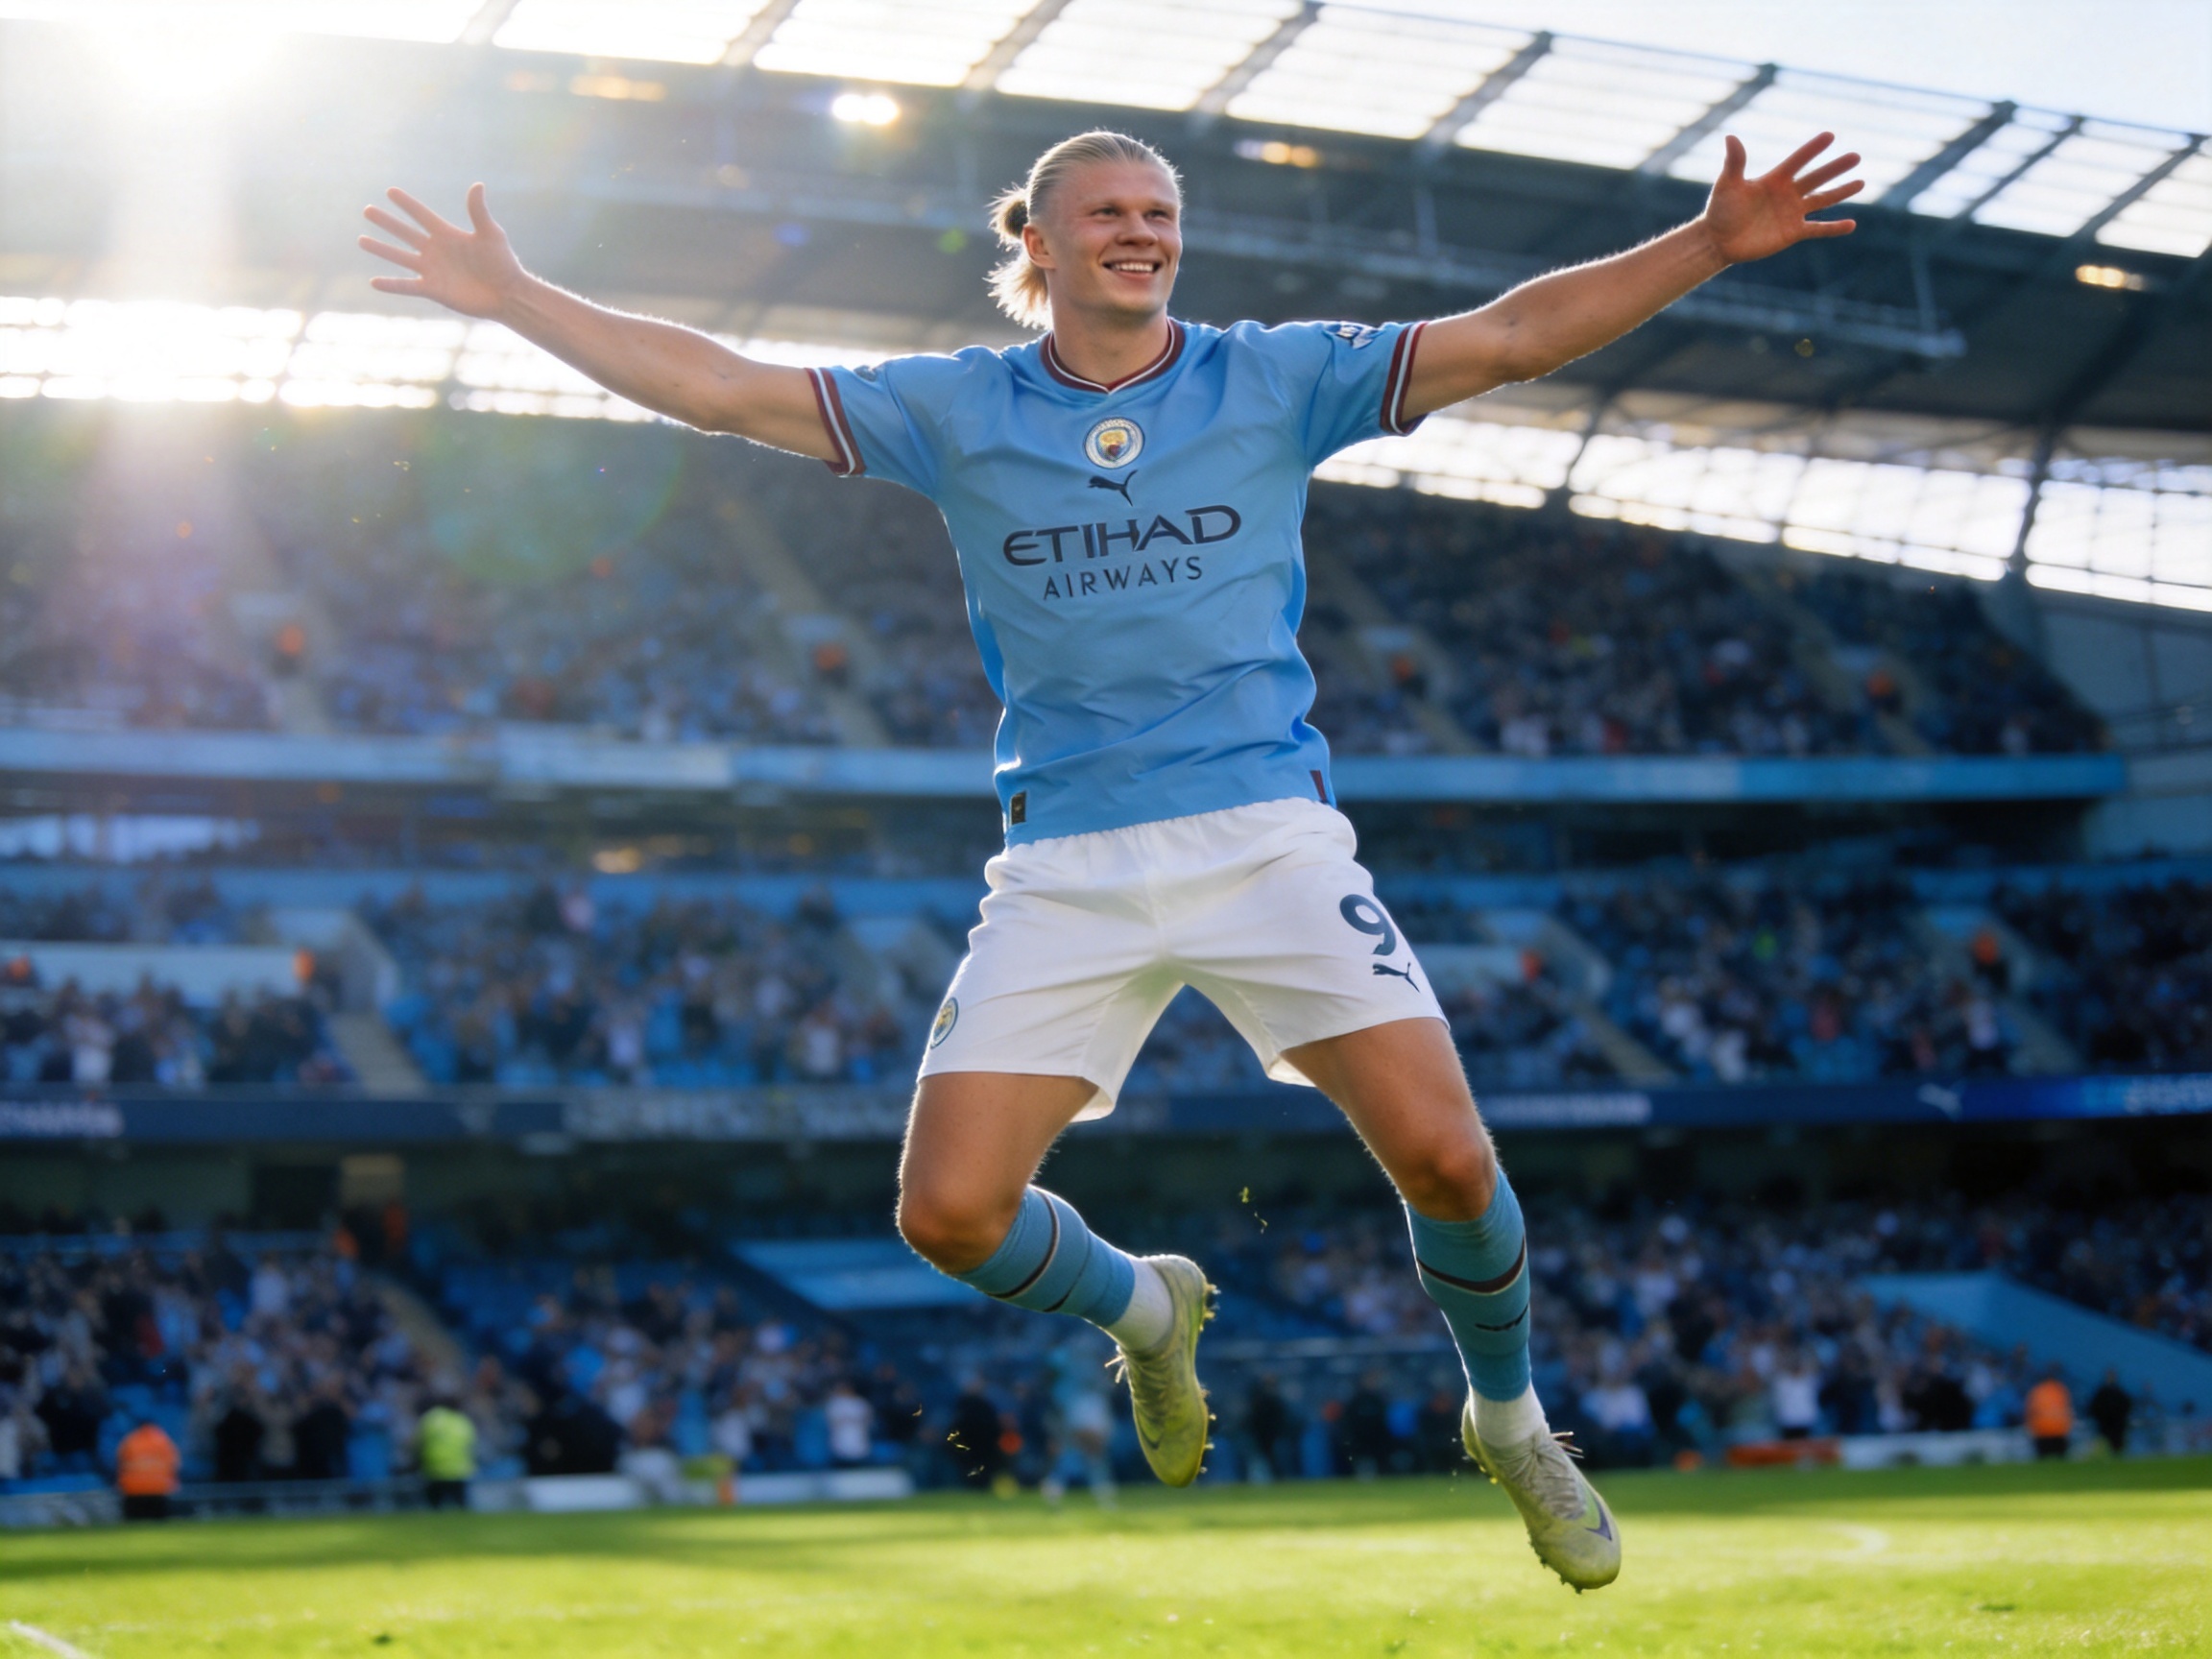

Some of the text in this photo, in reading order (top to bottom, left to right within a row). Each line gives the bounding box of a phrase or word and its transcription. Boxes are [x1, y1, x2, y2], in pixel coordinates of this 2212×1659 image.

[1003, 505, 1240, 565] ETIHAD
[1044, 556, 1202, 600] AIRWAYS
[1339, 894, 1396, 955] 9
